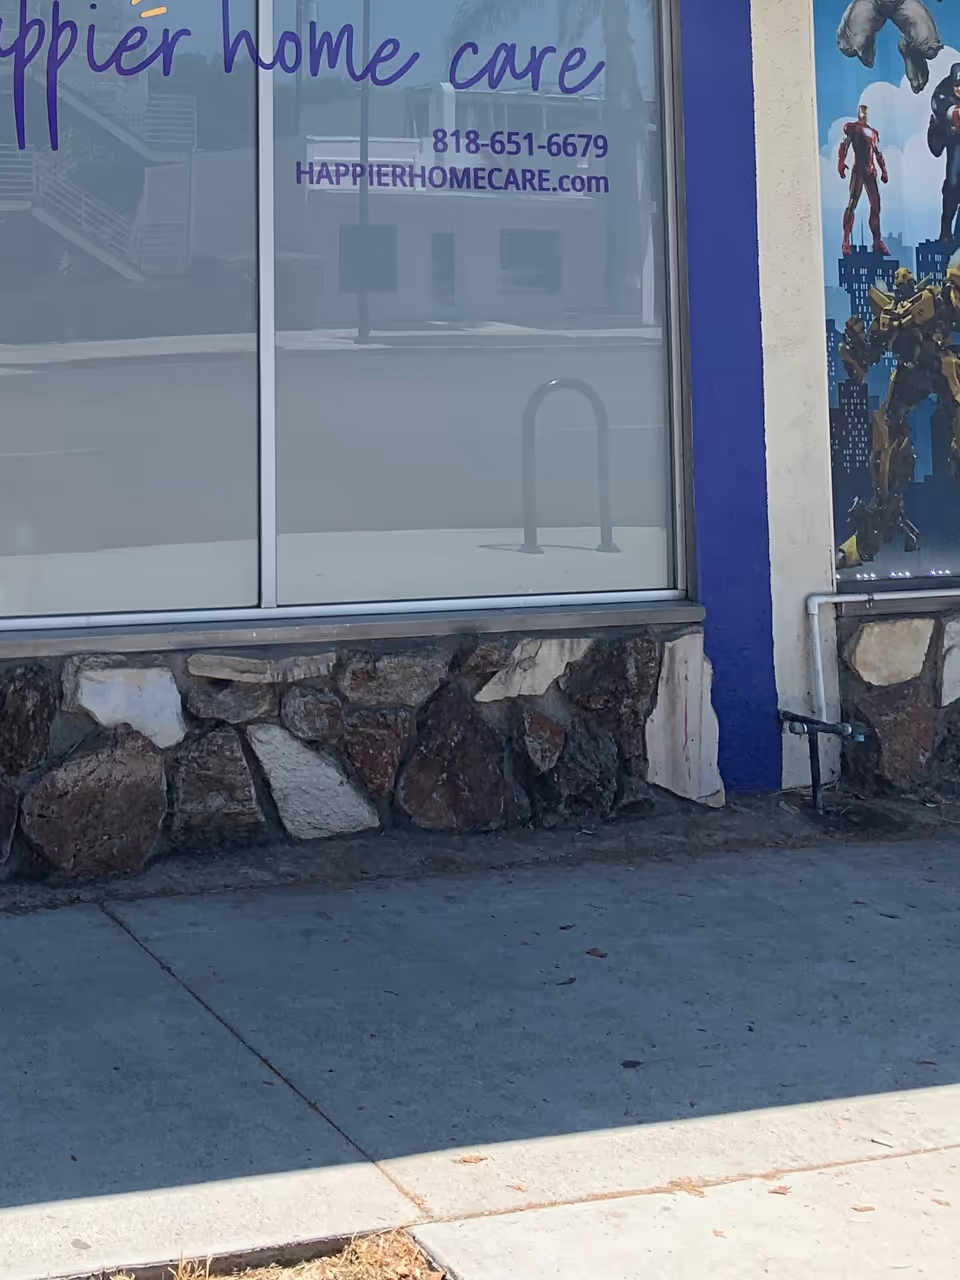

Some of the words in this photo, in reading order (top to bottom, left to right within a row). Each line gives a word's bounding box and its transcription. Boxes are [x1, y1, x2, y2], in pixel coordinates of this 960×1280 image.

[449, 41, 606, 94] care
[432, 128, 608, 158] 818-651-6679
[295, 161, 609, 193] HAPPIERHOMECARE.com
